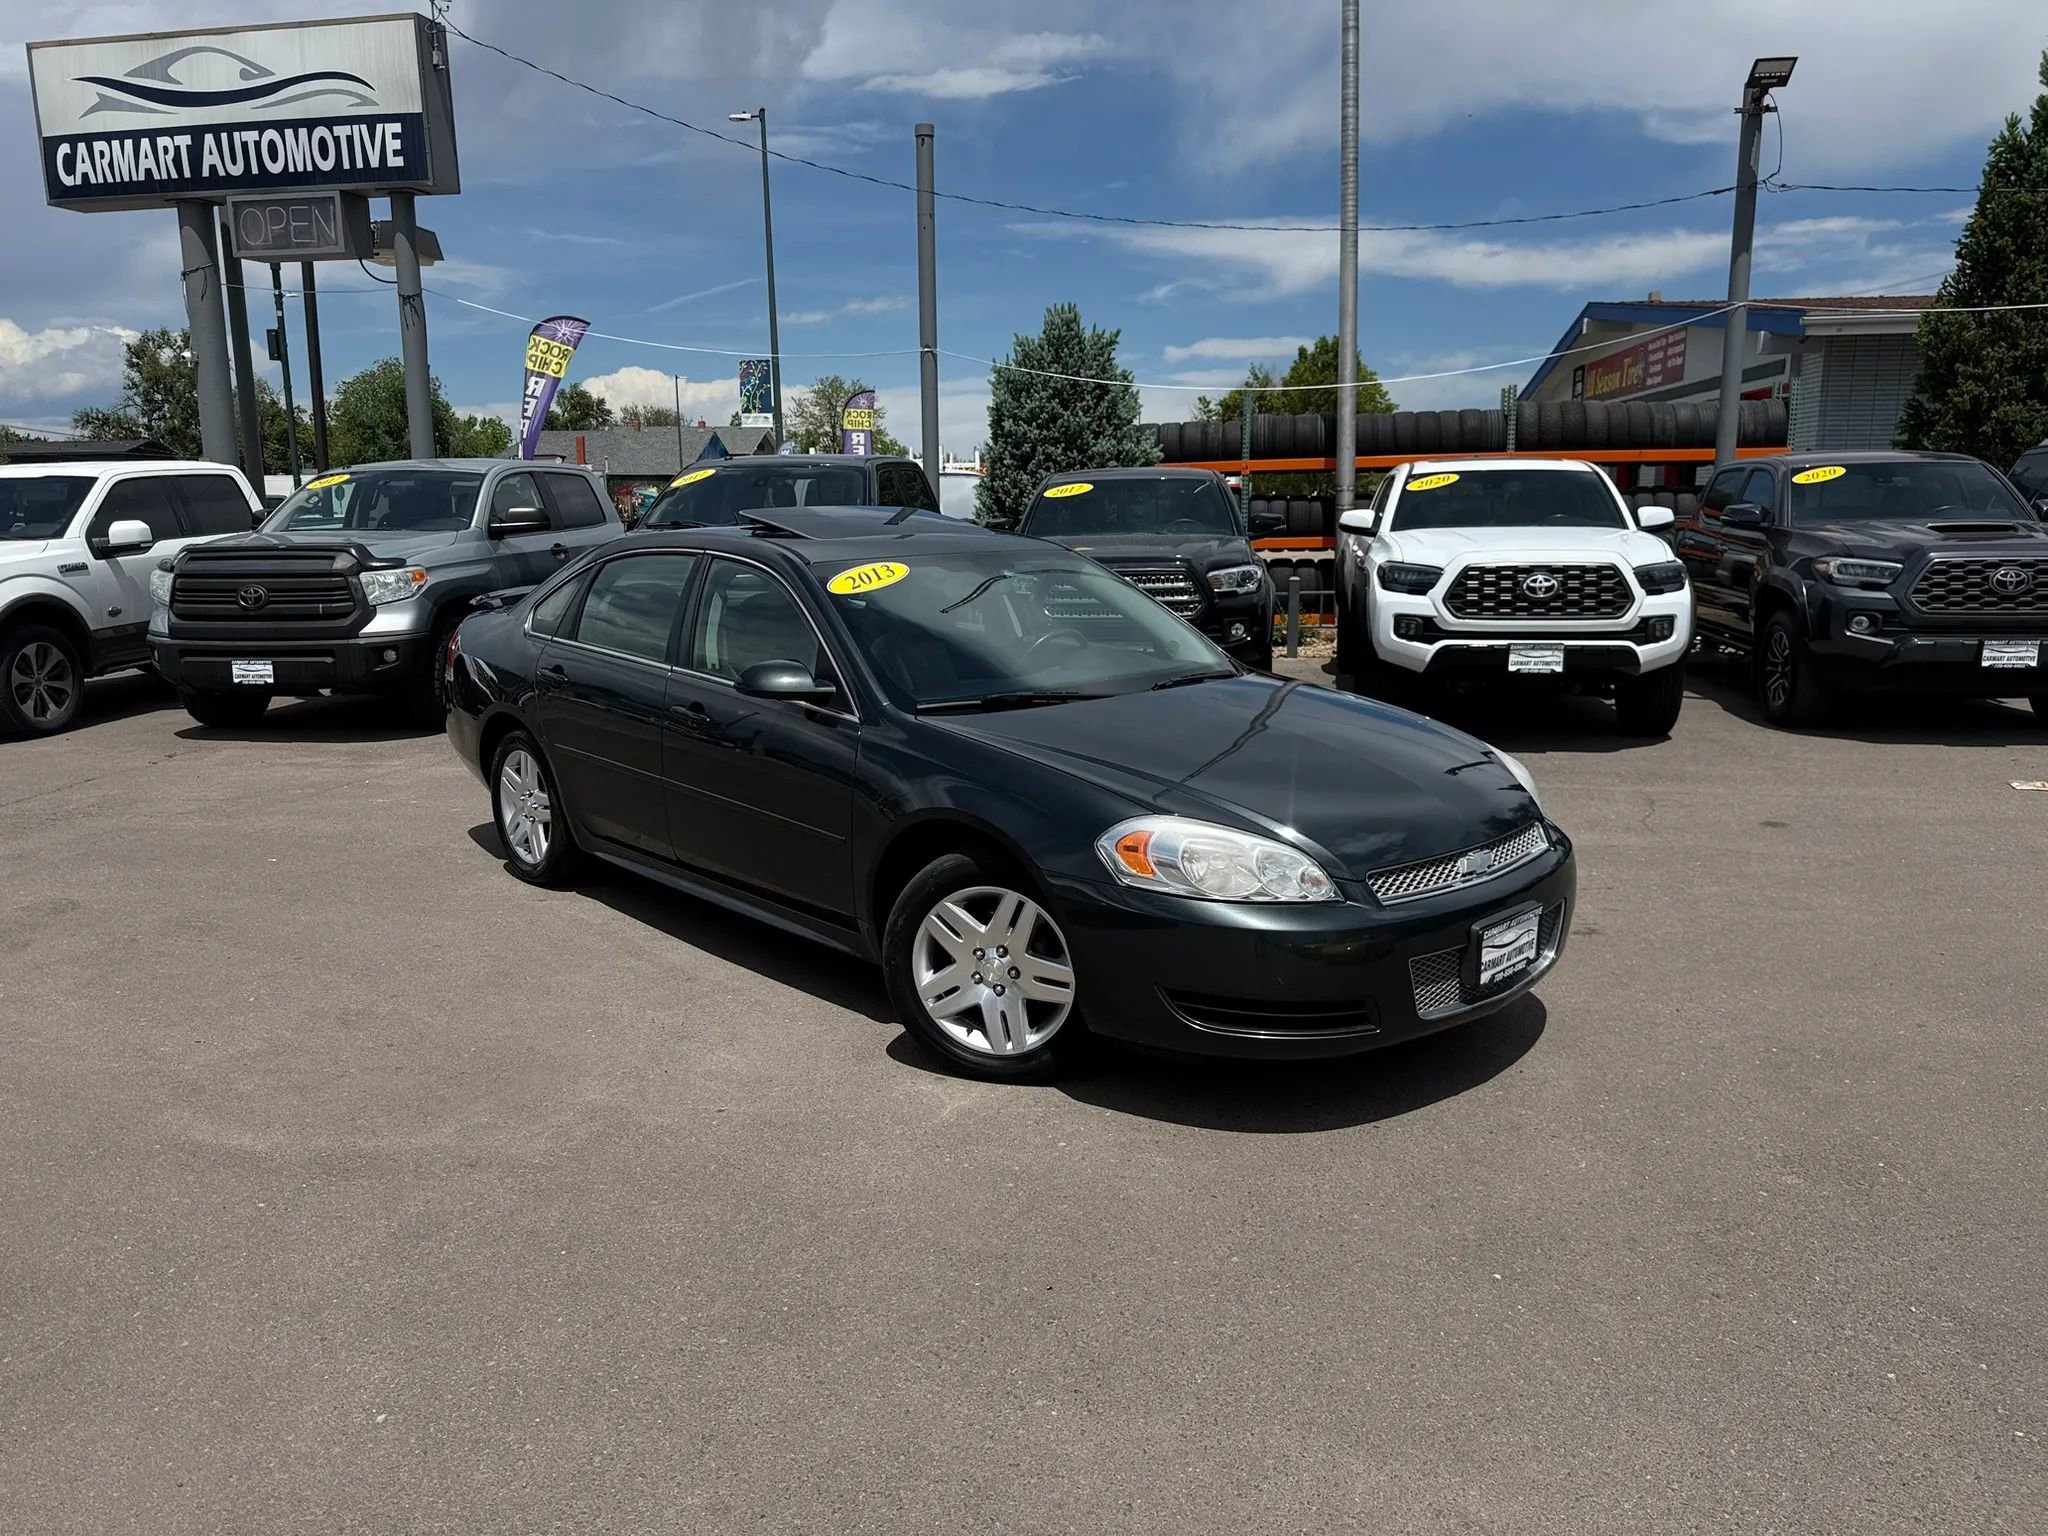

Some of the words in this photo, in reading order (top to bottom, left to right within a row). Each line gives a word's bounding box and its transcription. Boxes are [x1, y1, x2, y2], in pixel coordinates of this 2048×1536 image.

[56, 134, 193, 187] CARMART
[201, 122, 405, 178] AUTOMOTIVE
[239, 205, 336, 246] OPEN
[1417, 475, 1450, 488] 2020
[1803, 468, 1837, 481] 2020
[844, 564, 896, 590] 2013
[2006, 655, 2037, 663] AUTOMOTIVE
[1483, 921, 1511, 940] CARMART
[1481, 952, 1507, 972] CARMART
[1506, 937, 1535, 963] AUTOMOTIVE
